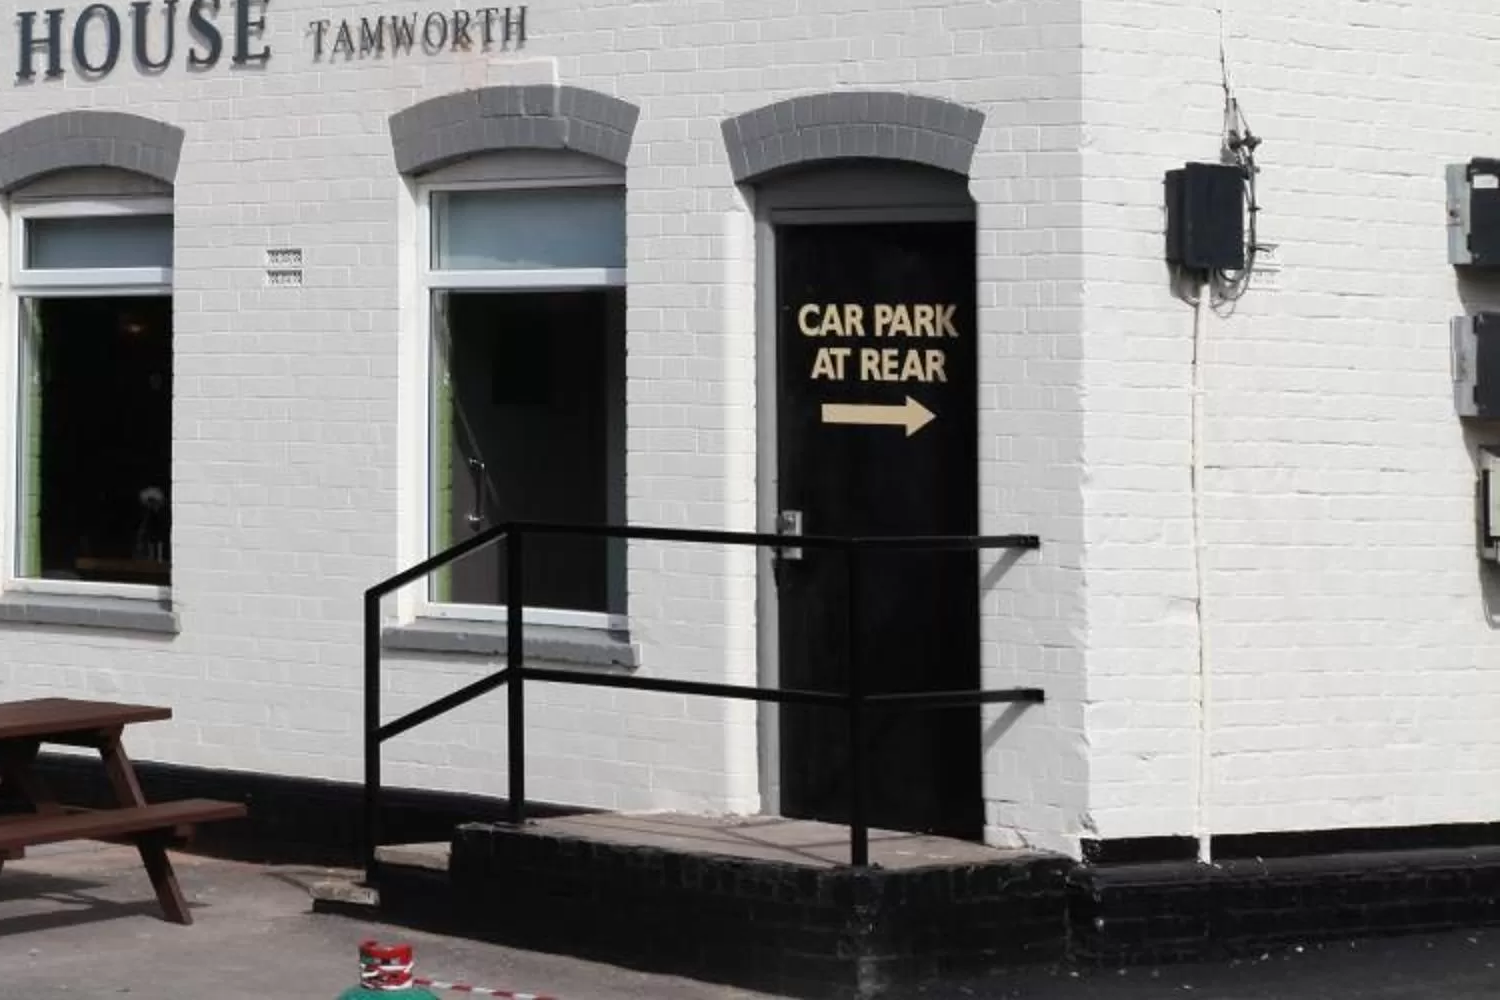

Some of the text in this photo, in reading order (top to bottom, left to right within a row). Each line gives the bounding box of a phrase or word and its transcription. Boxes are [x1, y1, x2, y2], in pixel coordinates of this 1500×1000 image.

[312, 5, 528, 60] TAMWORTH
[797, 303, 958, 338] CAR PARK
[810, 347, 947, 382] AT REAR
